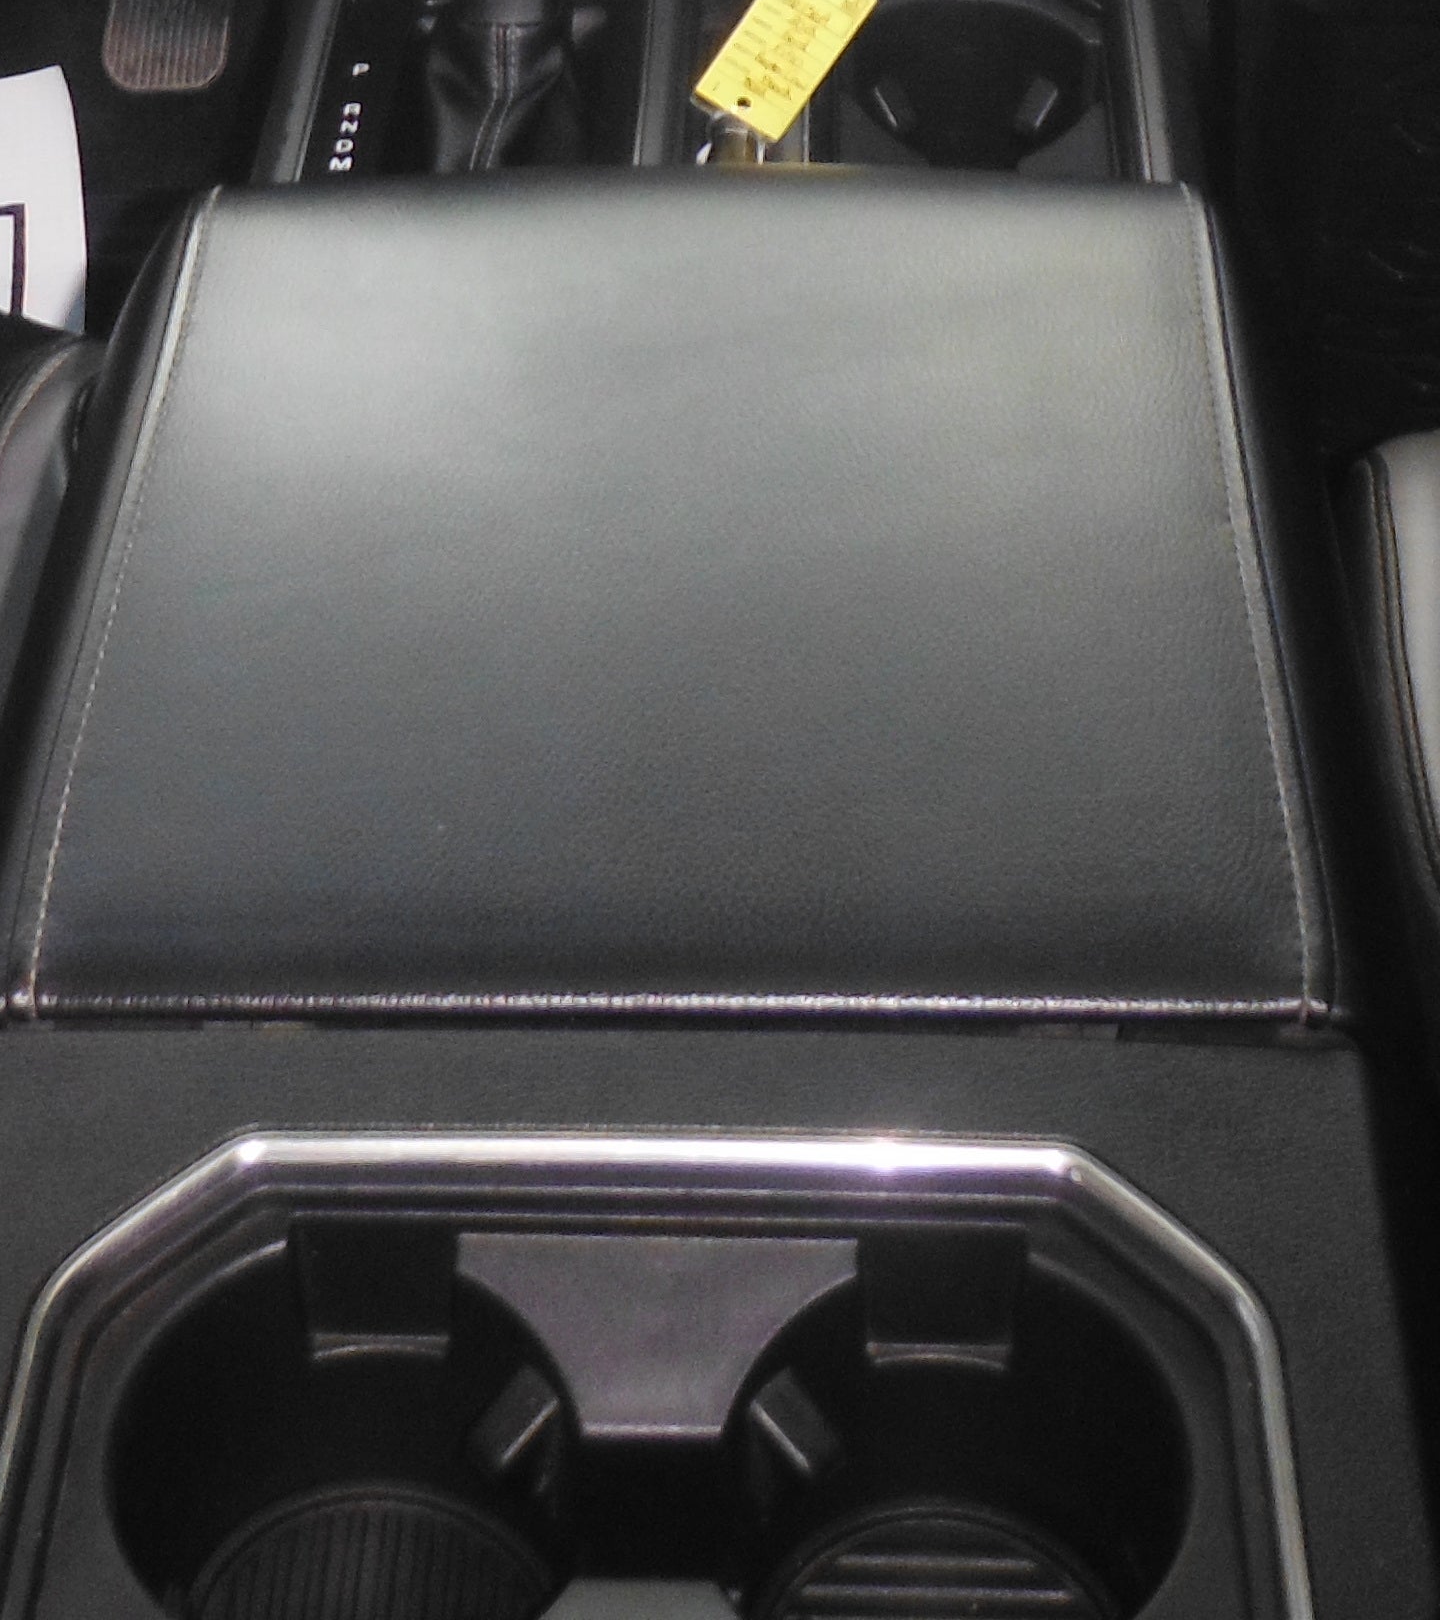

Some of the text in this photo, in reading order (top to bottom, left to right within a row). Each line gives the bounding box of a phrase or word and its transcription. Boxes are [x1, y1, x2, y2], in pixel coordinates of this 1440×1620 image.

[352, 62, 370, 77] P
[340, 119, 359, 135] N
[328, 156, 353, 171] M
